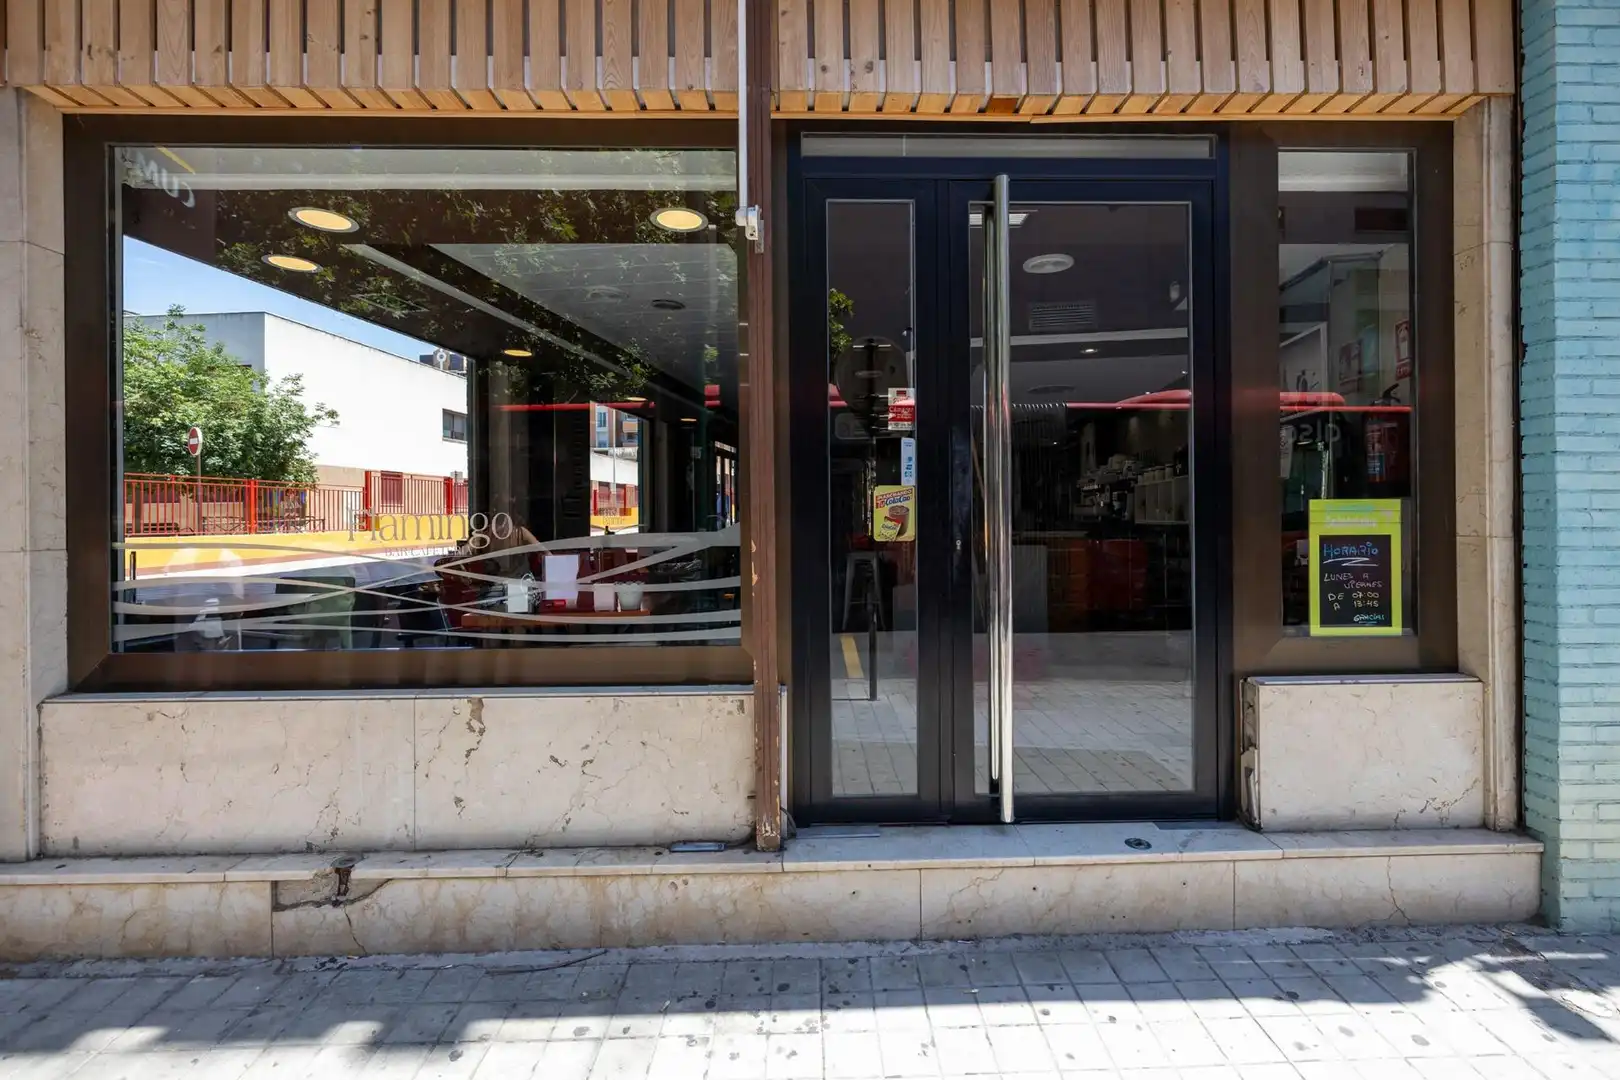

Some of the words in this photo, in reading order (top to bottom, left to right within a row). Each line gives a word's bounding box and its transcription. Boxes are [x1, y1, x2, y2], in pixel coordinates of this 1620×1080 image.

[348, 505, 513, 548] Flamingo
[1324, 573, 1353, 582] LUNES
[1328, 592, 1345, 601] DE
[1333, 602, 1341, 611] A
